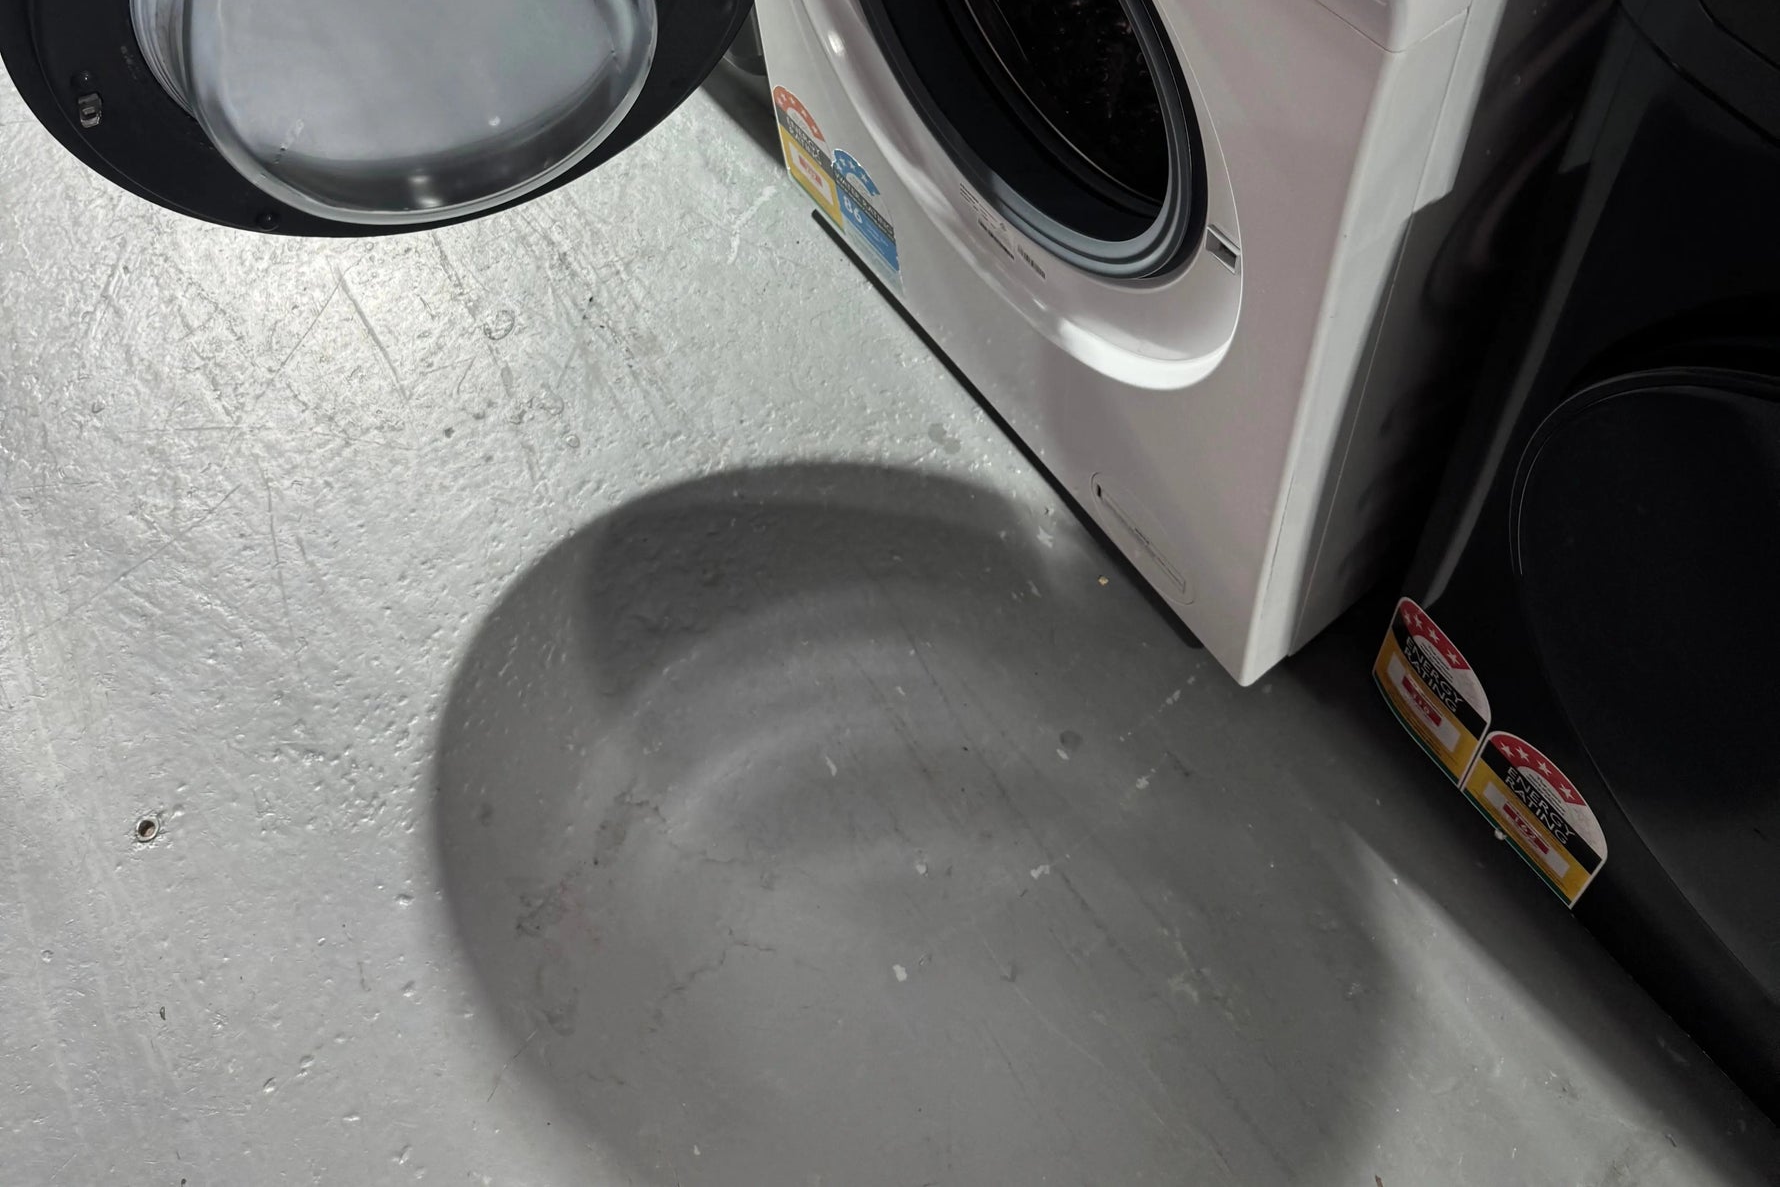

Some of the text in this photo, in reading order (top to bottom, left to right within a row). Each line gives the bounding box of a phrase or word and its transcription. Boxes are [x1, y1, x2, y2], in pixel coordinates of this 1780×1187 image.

[1404, 646, 1457, 713] RATING
[1406, 636, 1464, 703] ENERGY
[1505, 776, 1568, 844] RATING
[1508, 767, 1576, 836] ENERGY
